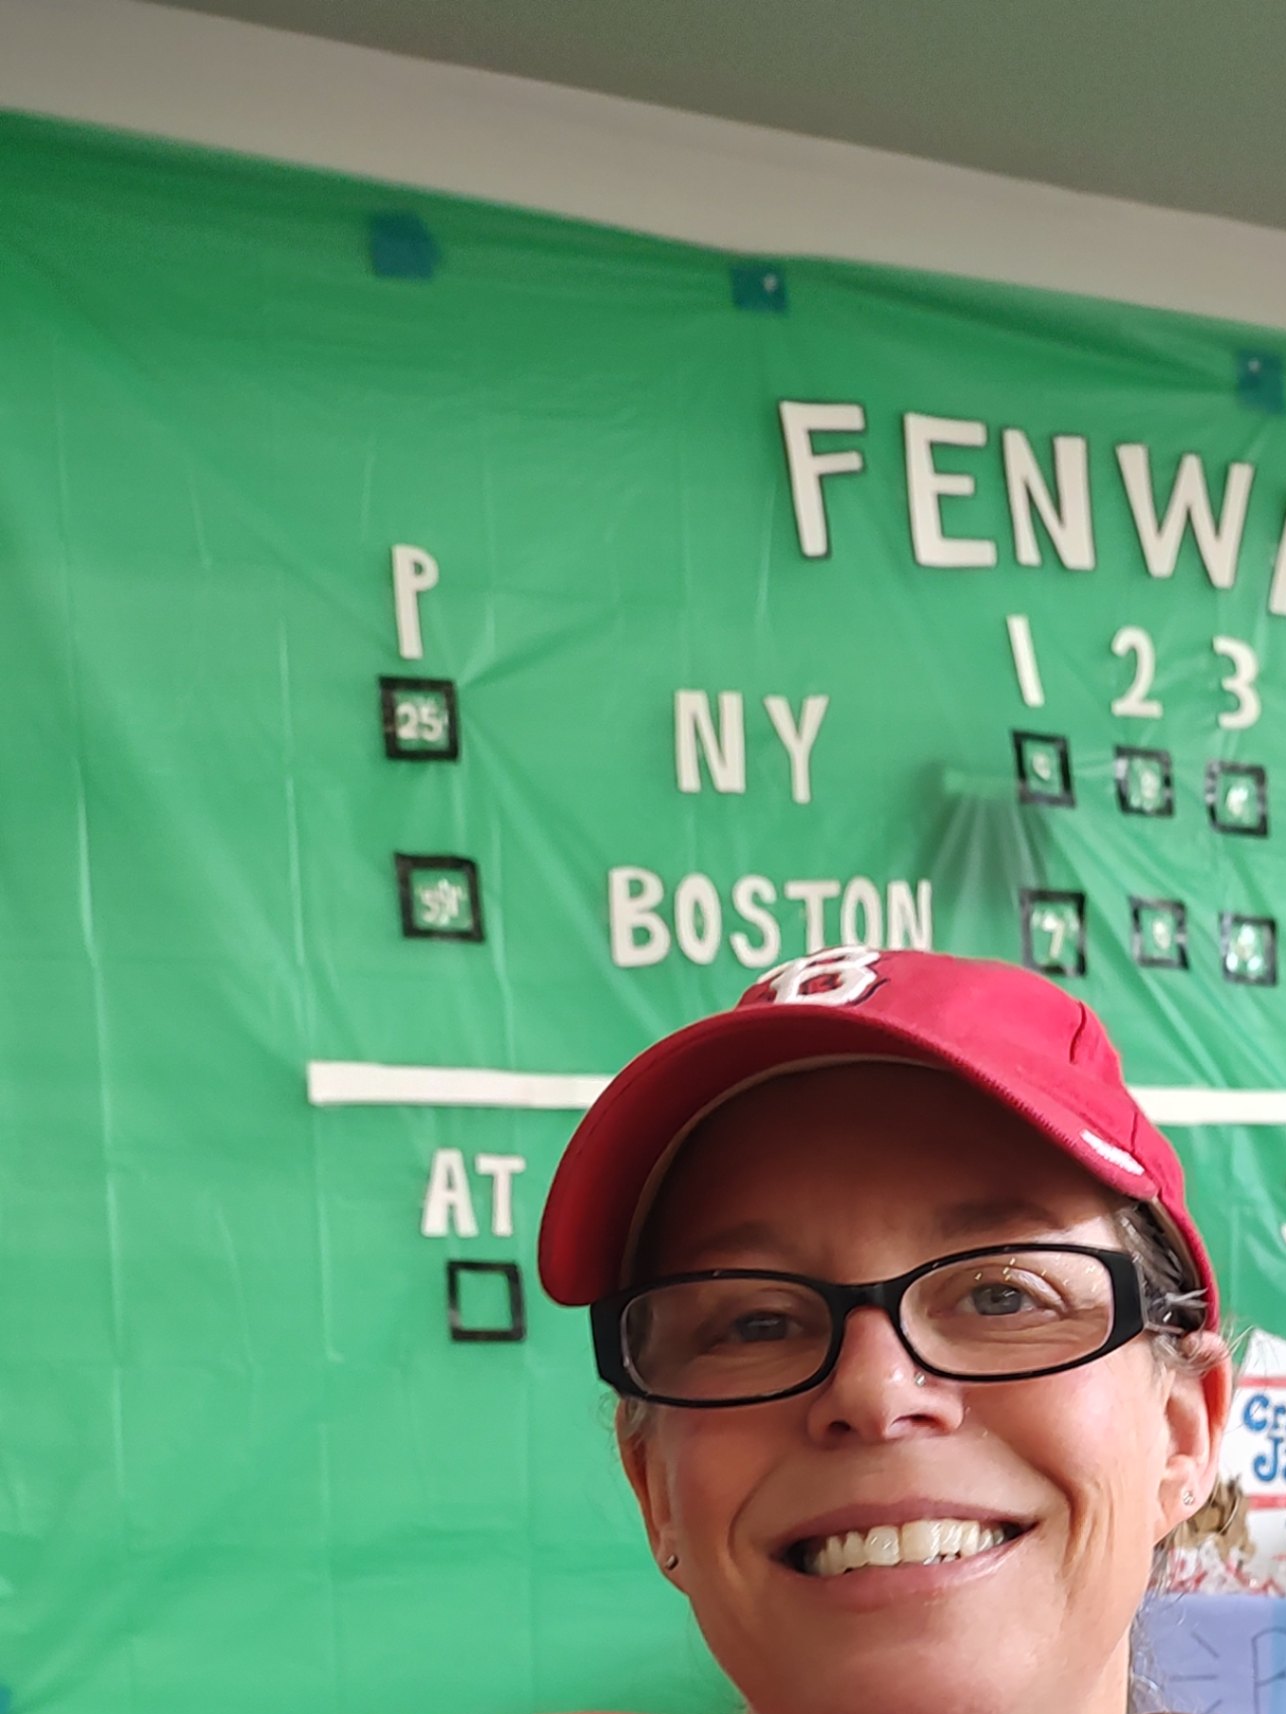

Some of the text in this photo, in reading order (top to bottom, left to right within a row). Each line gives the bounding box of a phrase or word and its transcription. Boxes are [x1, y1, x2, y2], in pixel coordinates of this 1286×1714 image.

[393, 545, 438, 659] P
[1008, 617, 1042, 706] 1
[1112, 628, 1161, 717] 2
[1214, 637, 1260, 729] 3
[674, 690, 829, 803] NY
[608, 866, 934, 968] BOSTON
[421, 1148, 526, 1238] AT
